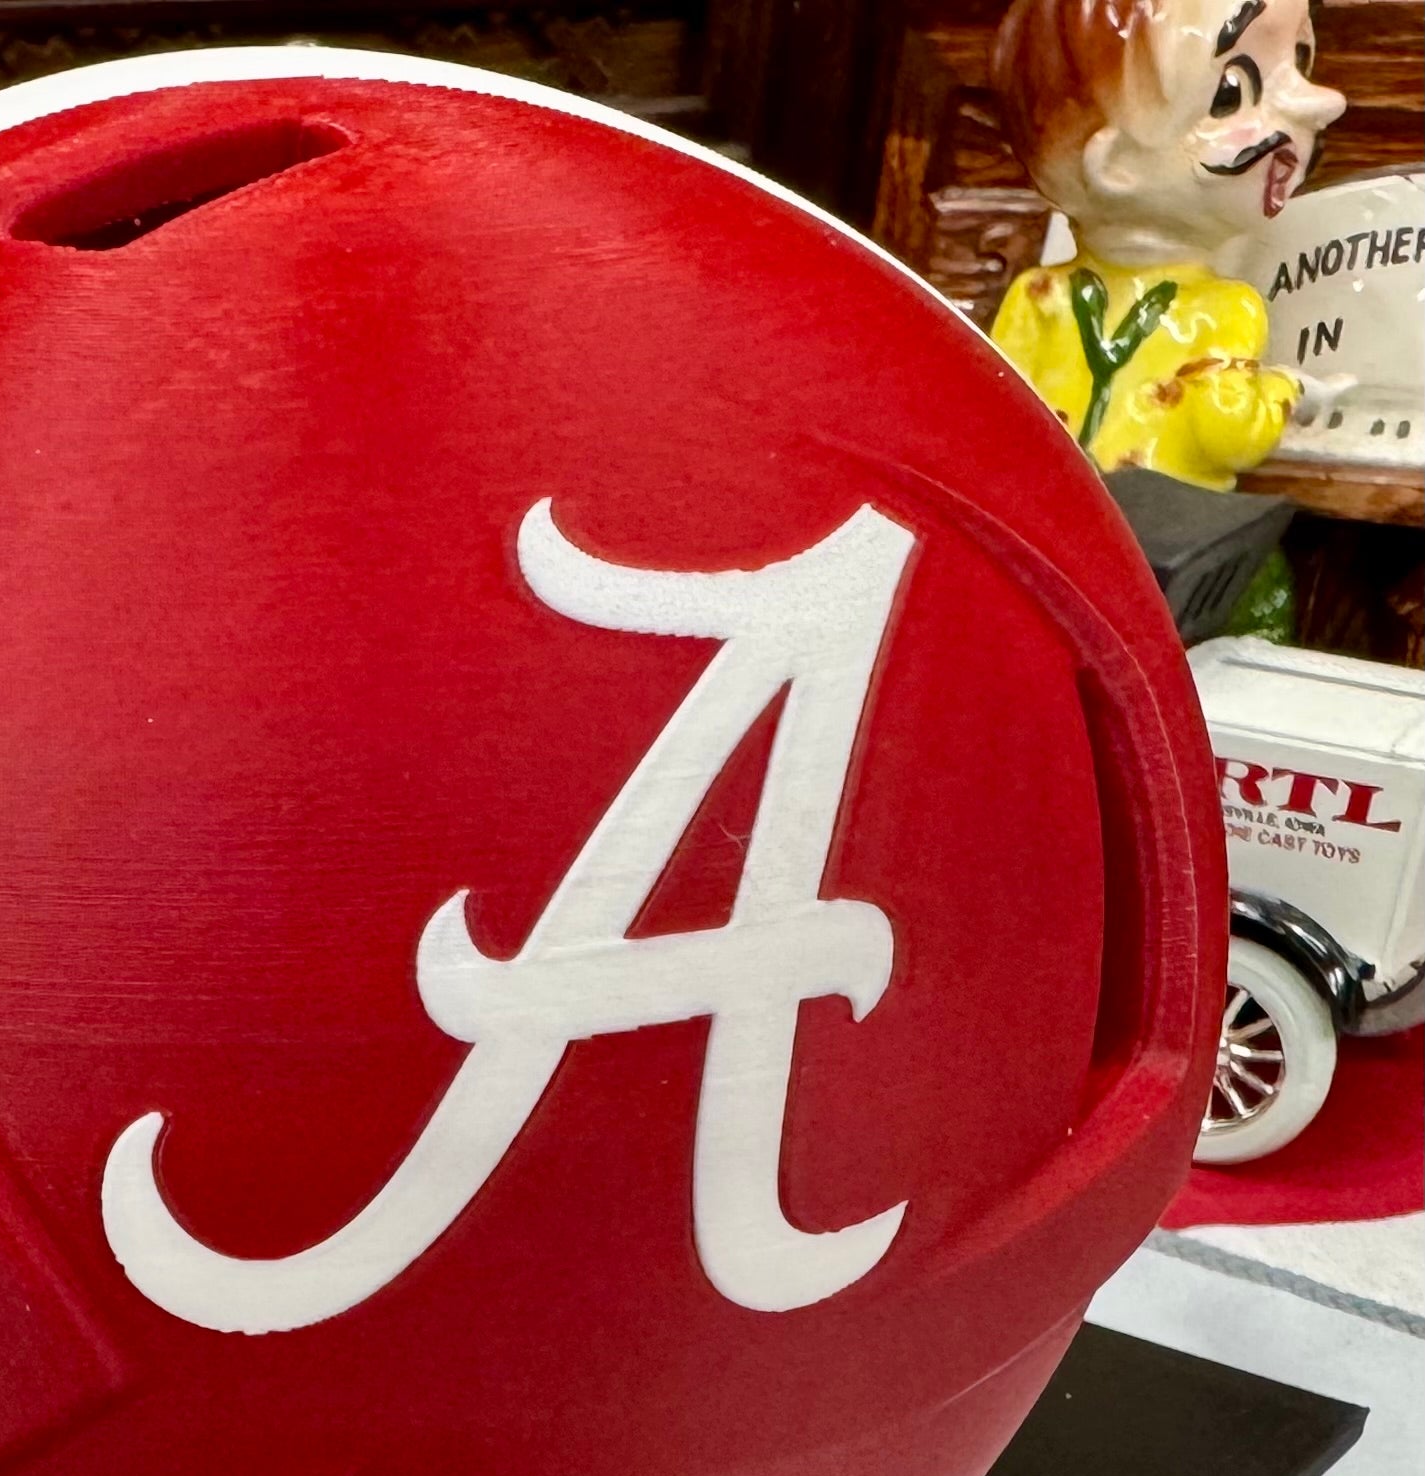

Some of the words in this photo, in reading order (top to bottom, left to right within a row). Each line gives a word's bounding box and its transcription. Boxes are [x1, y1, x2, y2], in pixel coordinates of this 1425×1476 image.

[1296, 316, 1344, 366] IN
[1311, 839, 1362, 864] TOYS
[101, 495, 917, 1335] A
